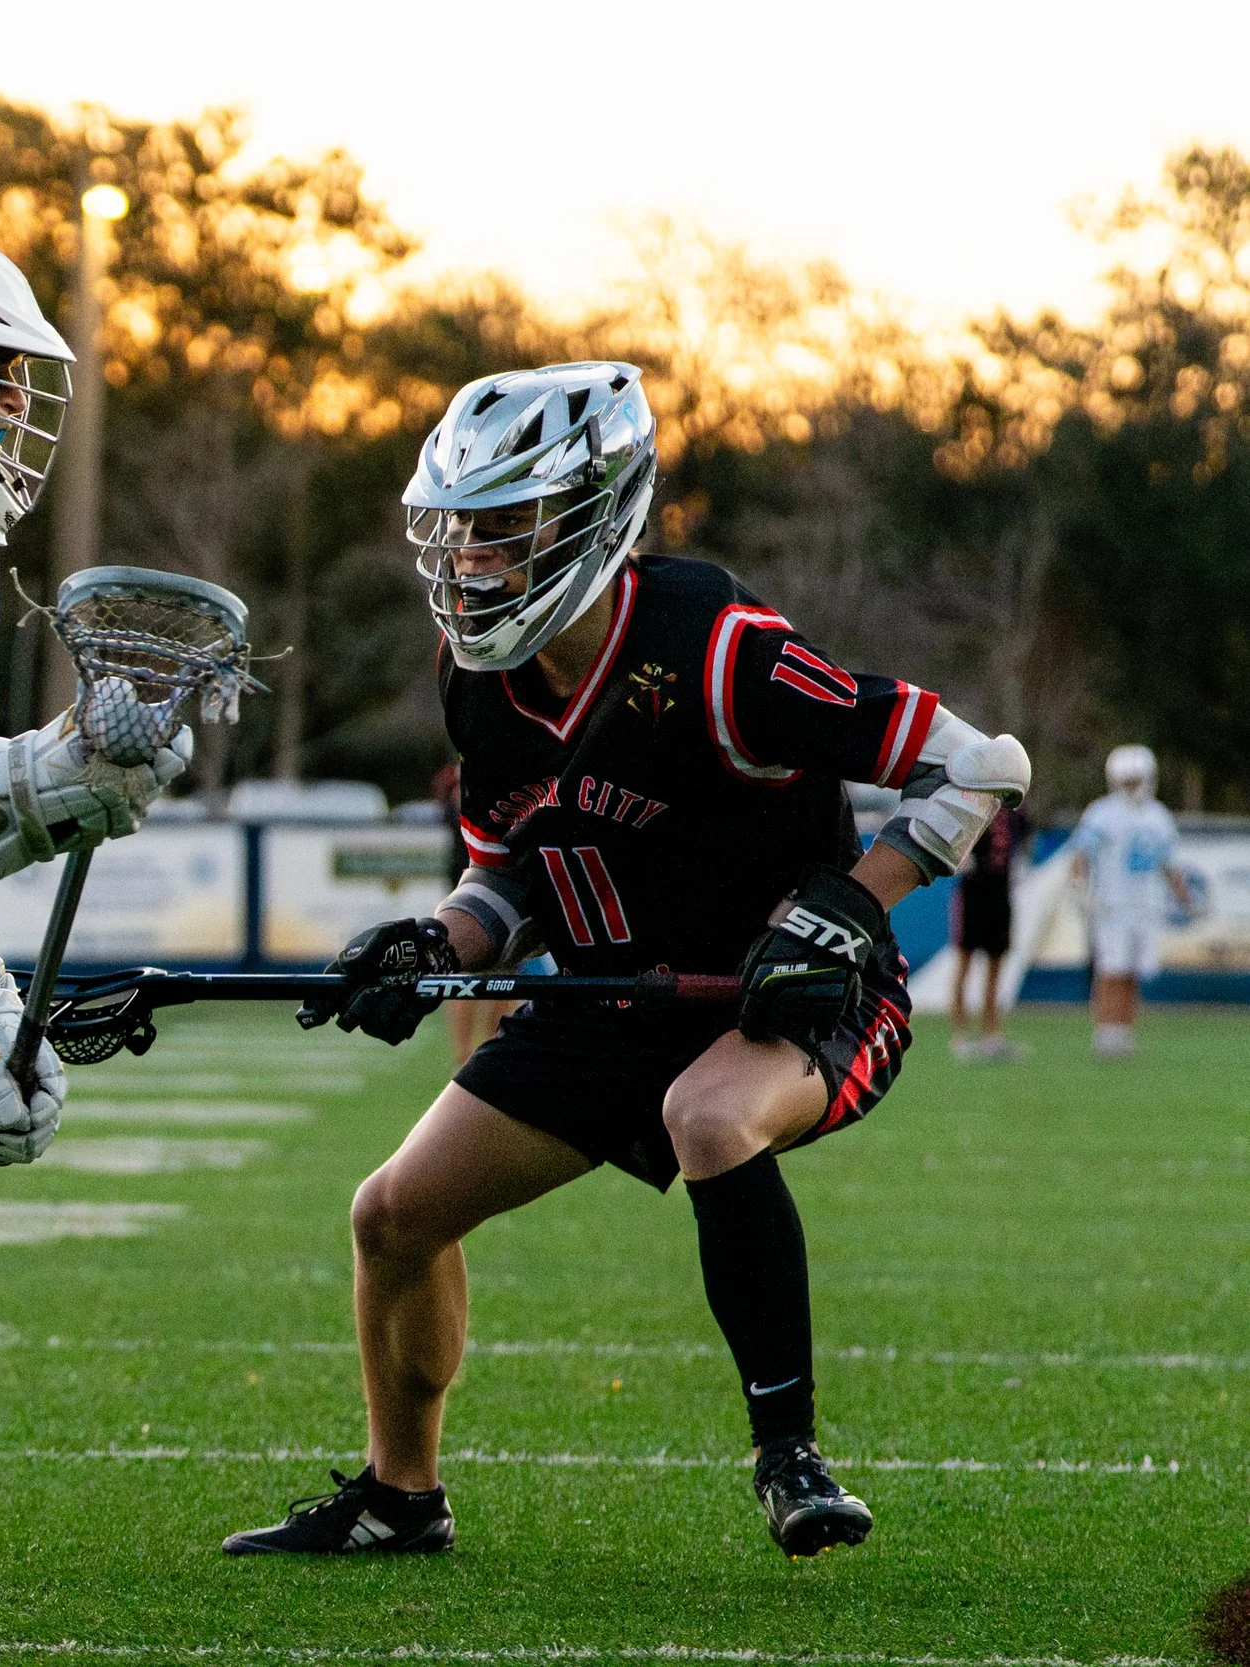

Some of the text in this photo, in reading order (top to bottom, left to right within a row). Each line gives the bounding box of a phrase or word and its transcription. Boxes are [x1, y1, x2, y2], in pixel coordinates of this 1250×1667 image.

[770, 641, 858, 708] 11
[579, 776, 668, 829] CITY
[538, 846, 631, 946] 11
[779, 906, 866, 963] STX
[415, 980, 516, 997] STX 6000
